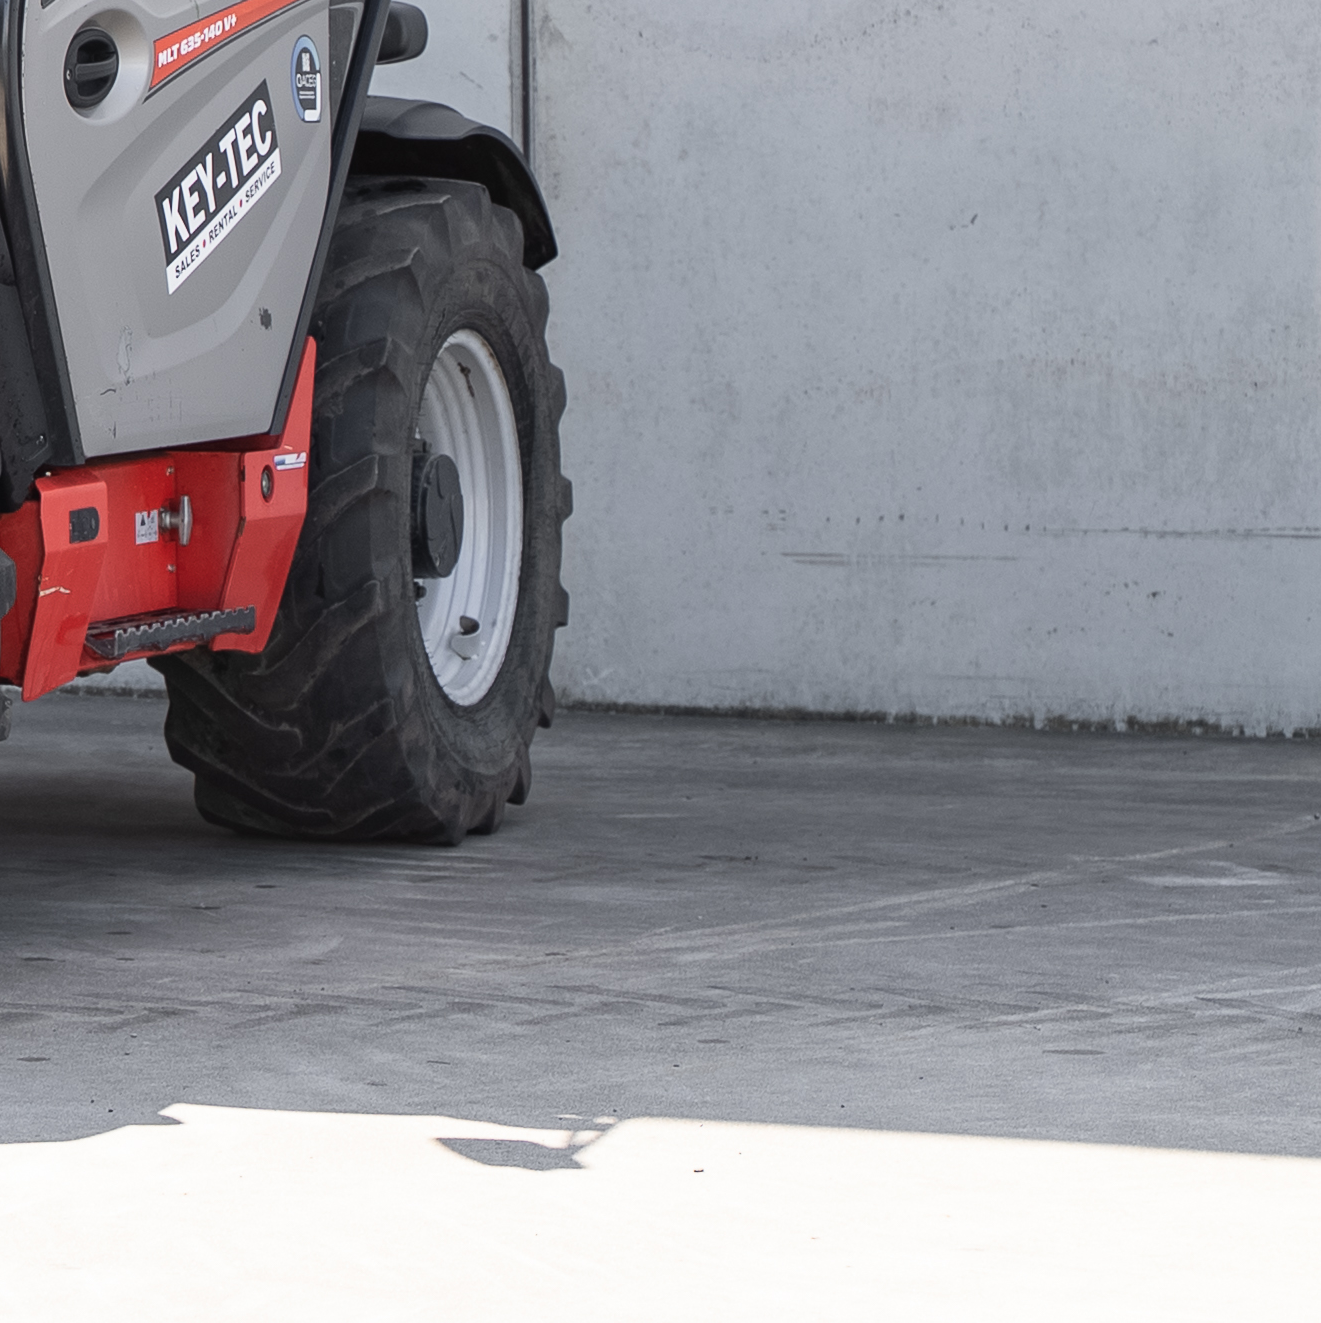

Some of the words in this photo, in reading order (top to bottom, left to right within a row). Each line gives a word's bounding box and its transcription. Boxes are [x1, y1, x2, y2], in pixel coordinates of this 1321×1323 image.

[158, 43, 179, 68] MLT
[180, 20, 223, 55] 635-140
[162, 99, 273, 253] KEY-TEC
[175, 244, 200, 279] SALES
[209, 205, 238, 243] RENTAL
[245, 161, 276, 203] SERVICE
